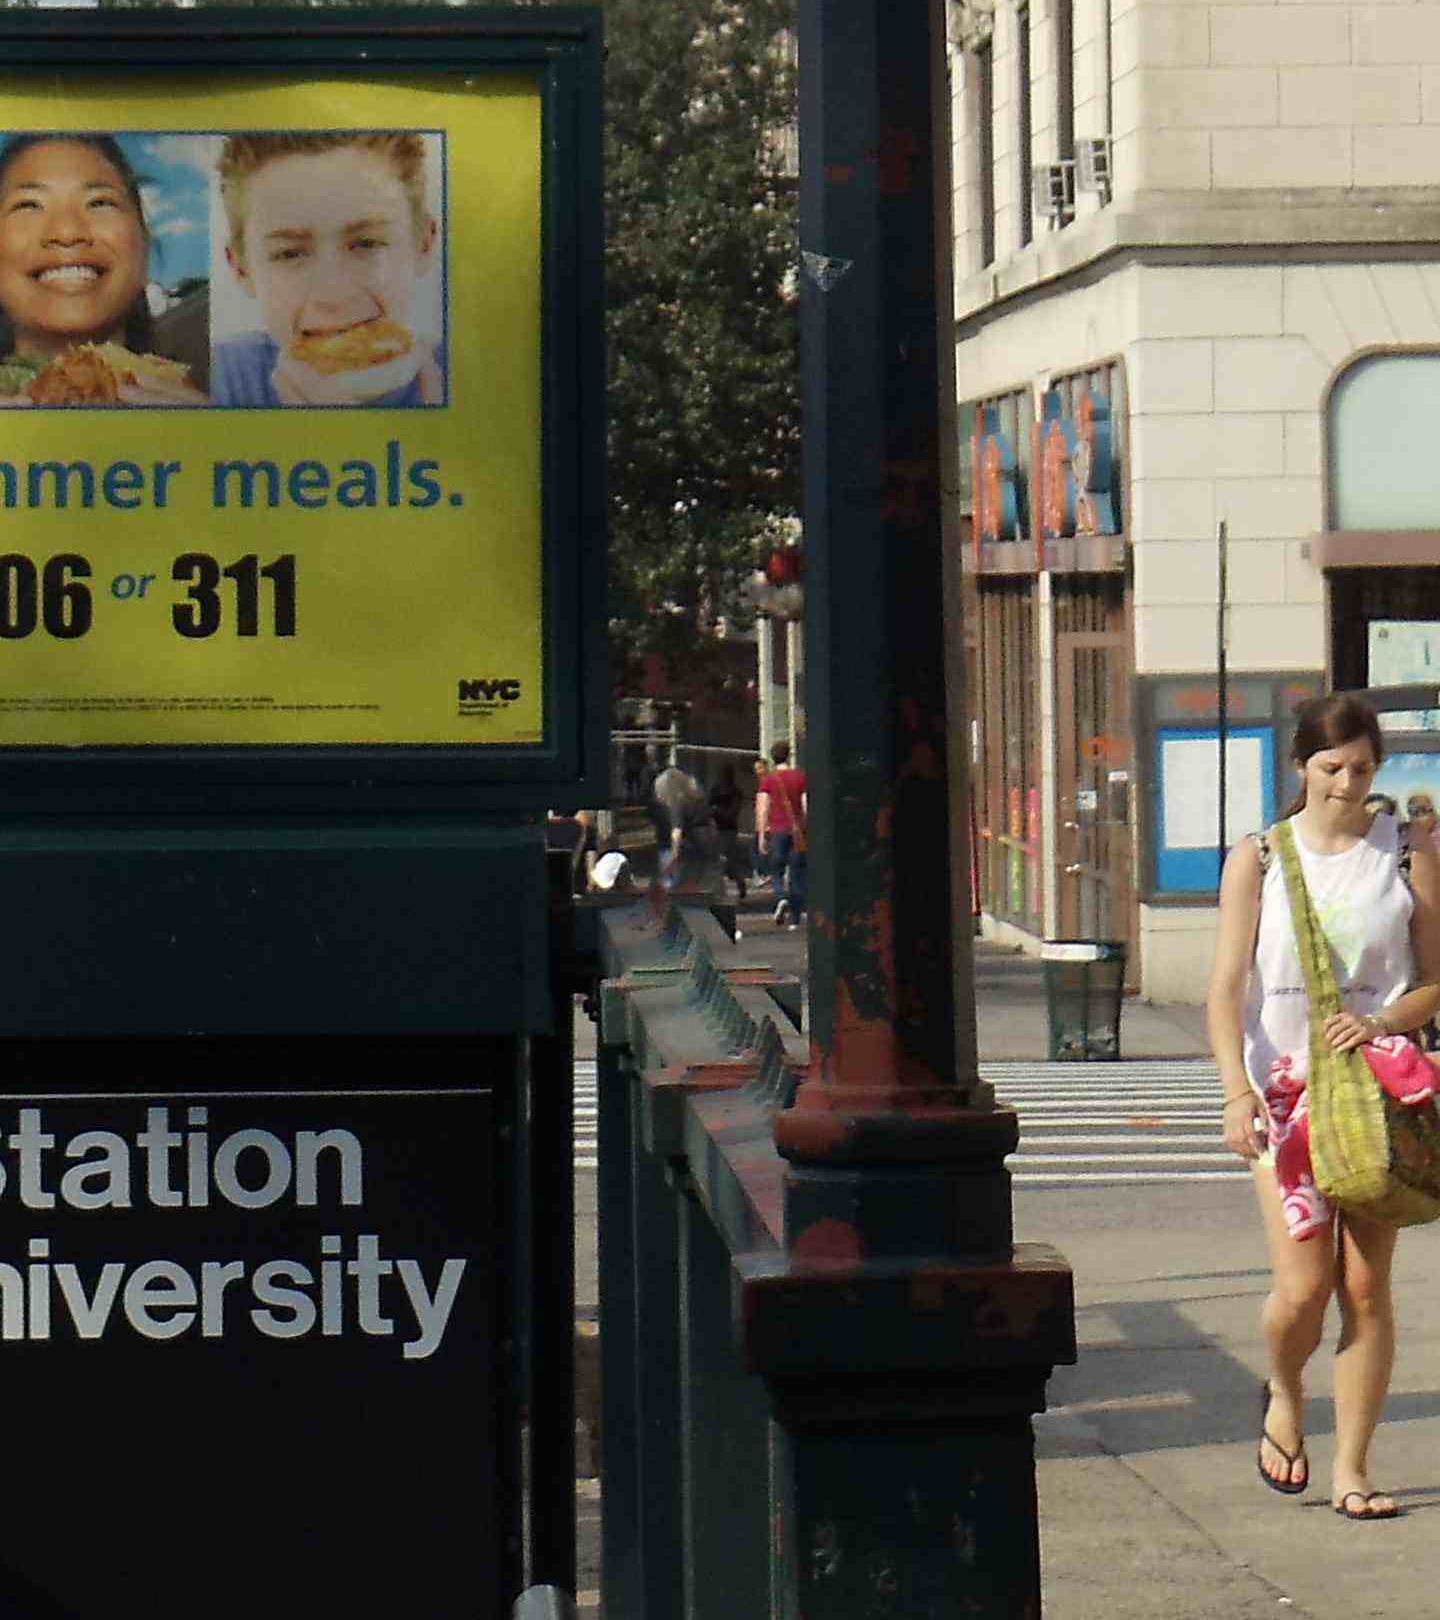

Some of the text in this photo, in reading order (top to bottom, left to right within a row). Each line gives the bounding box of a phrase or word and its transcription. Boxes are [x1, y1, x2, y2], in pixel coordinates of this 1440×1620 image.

[212, 440, 464, 509] meals.
[110, 569, 156, 600] or
[171, 553, 298, 639] 311
[458, 679, 521, 701] NYC
